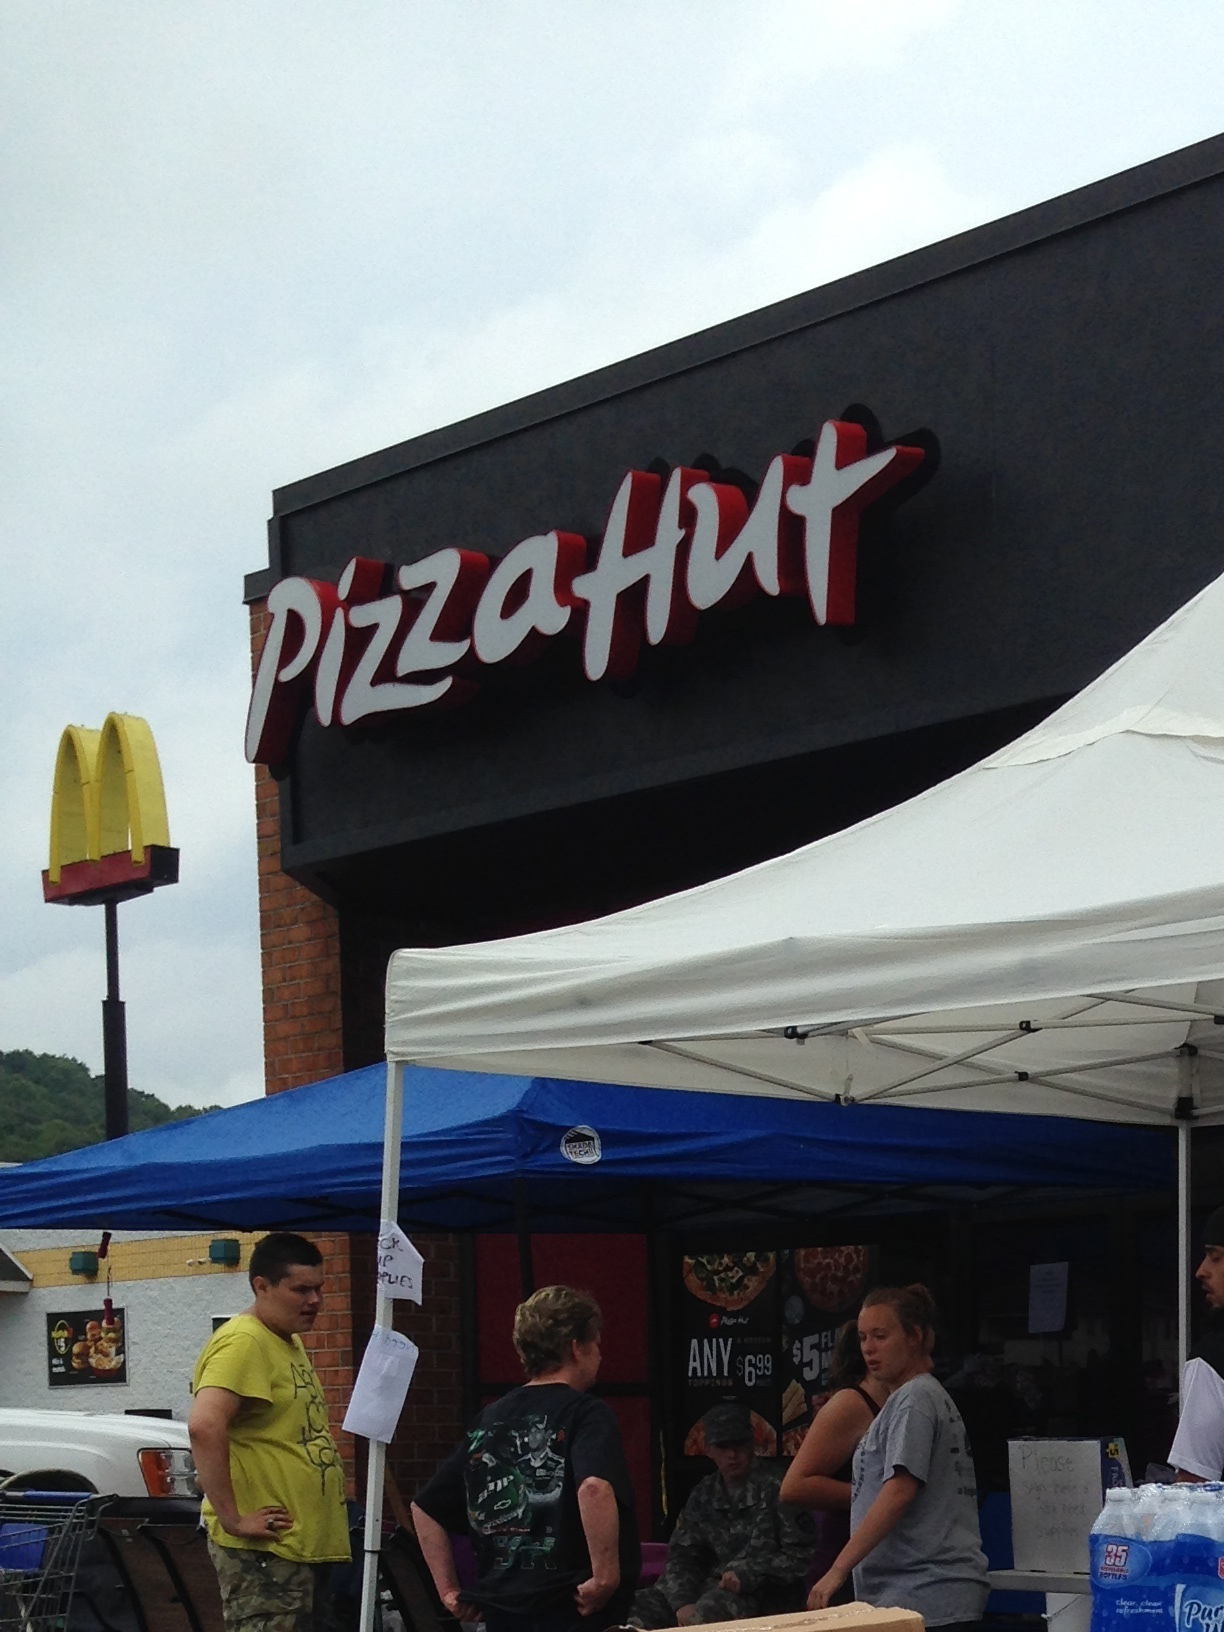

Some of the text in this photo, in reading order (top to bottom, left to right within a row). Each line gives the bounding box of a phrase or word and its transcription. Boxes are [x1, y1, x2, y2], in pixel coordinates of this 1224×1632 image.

[571, 420, 900, 681] Hut
[379, 1237, 403, 1252] CK
[688, 1337, 733, 1378] ANY
[1105, 1543, 1130, 1567] 35
